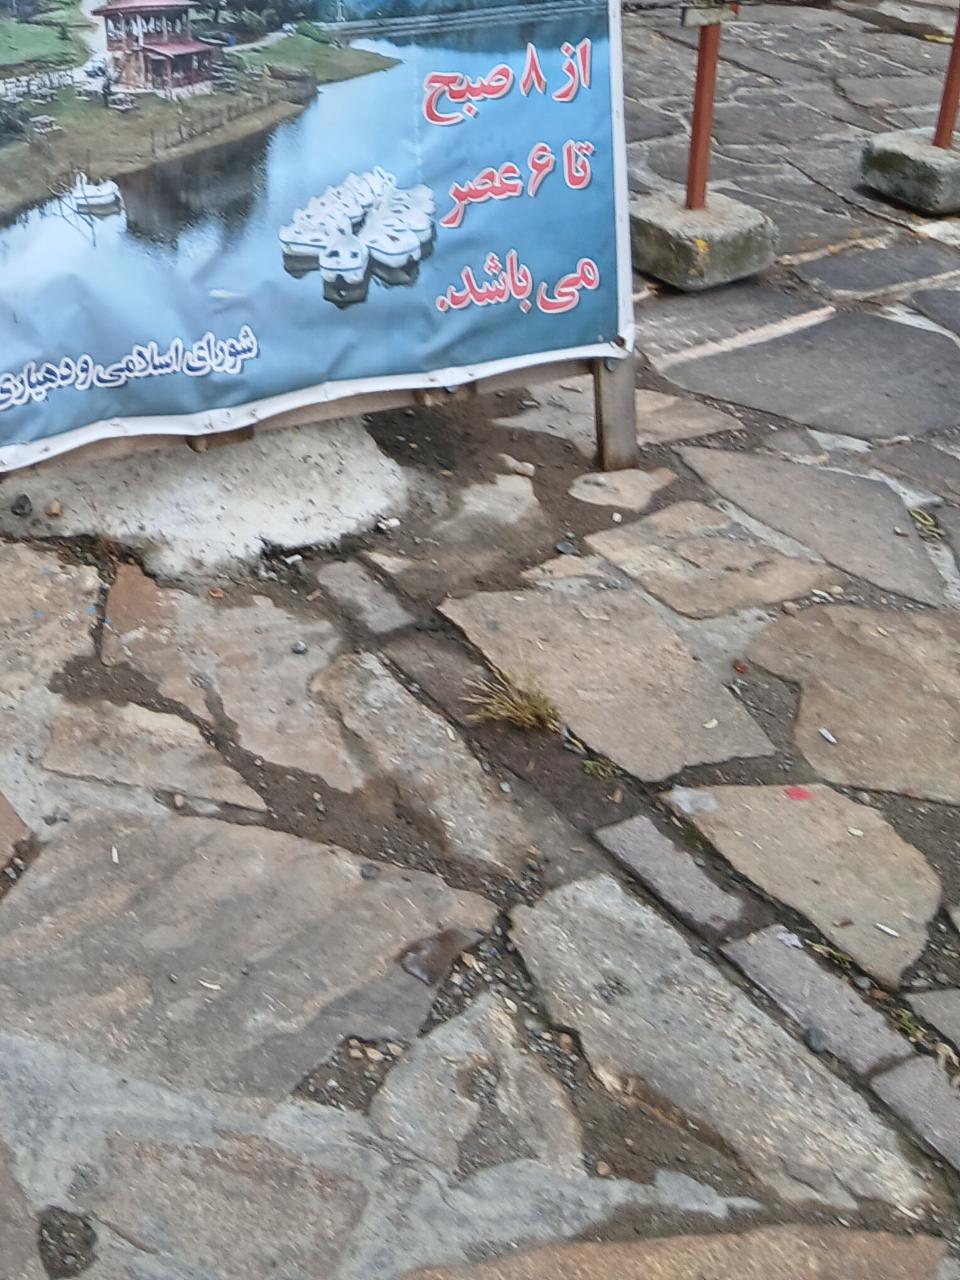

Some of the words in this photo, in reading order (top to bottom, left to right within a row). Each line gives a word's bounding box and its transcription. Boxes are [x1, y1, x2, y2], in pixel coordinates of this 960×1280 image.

[423, 62, 514, 125] صبح
[552, 37, 592, 102] از
[562, 139, 595, 190] تا
[440, 162, 523, 228] عصر
[536, 257, 600, 314] می
[94, 338, 183, 387] اسلامی
[184, 324, 260, 375] شورای
